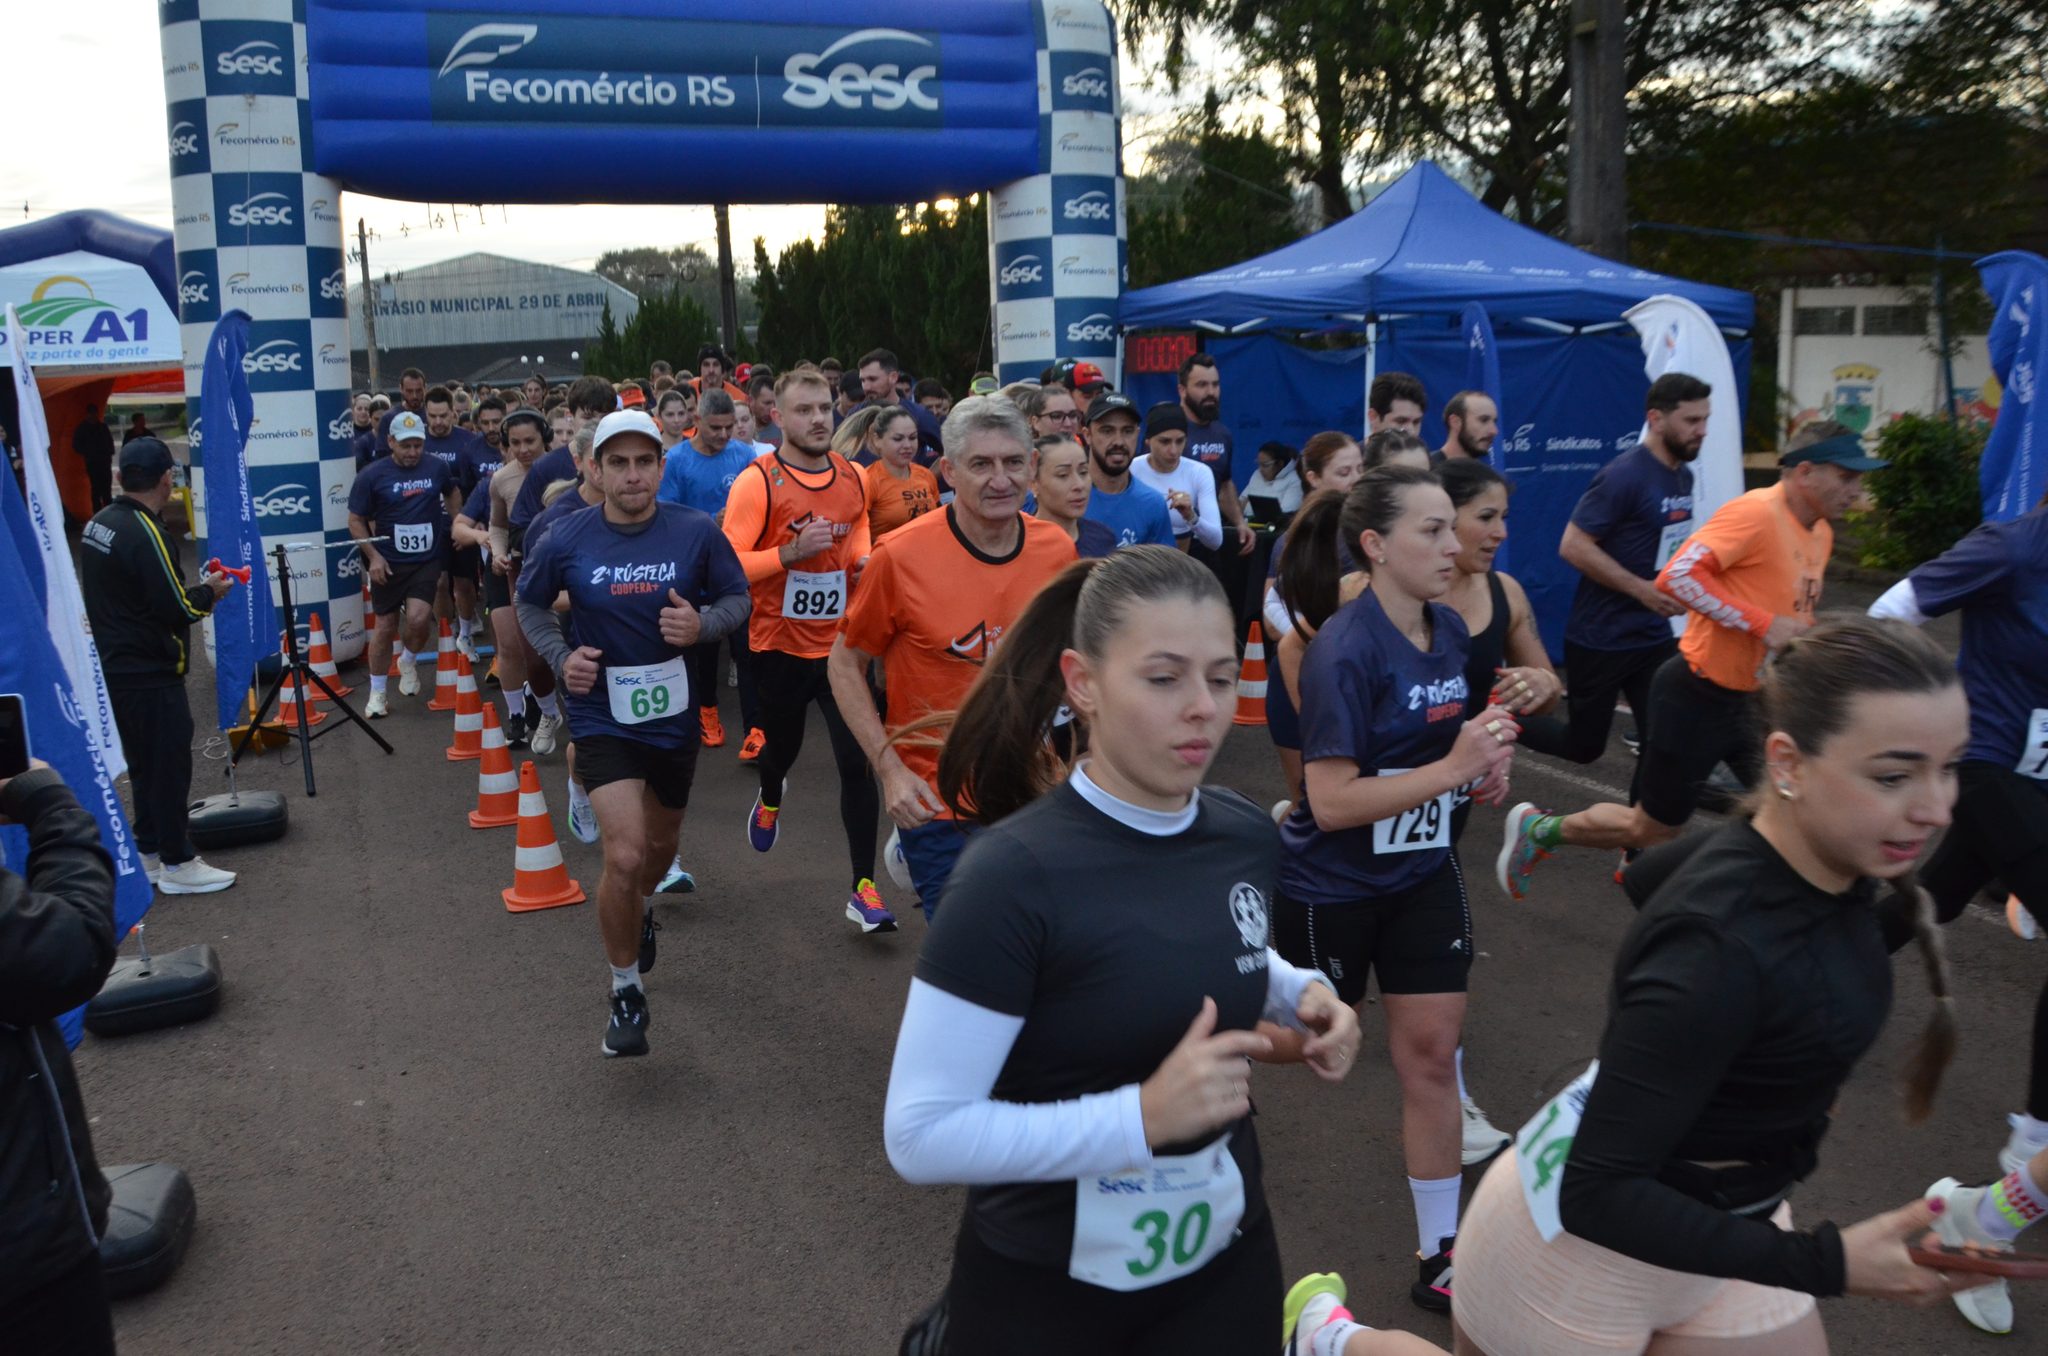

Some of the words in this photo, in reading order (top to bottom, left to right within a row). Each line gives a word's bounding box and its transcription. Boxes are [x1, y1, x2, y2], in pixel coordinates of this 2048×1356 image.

[217, 52, 282, 76] Sesc
[464, 71, 677, 106] Fecomércio
[687, 75, 735, 107] RS
[783, 52, 938, 111] Sesc
[220, 133, 279, 146] Fecomércio
[281, 136, 296, 146] RS
[228, 203, 292, 226] Sesc
[1063, 199, 1110, 220] Sesc
[1001, 264, 1042, 286] Sesc
[231, 283, 289, 295] Fecomércio
[291, 283, 304, 293] RS
[320, 277, 346, 299] Ses
[430, 296, 514, 314] MUNICIPAL
[519, 294, 539, 310] 29
[542, 293, 562, 308] DE
[566, 291, 608, 307] ABRIL
[82, 308, 149, 344] A1
[1066, 322, 1113, 342] Sesc
[42, 348, 82, 362] parte
[86, 345, 104, 359] da
[105, 345, 150, 360] gente
[241, 351, 302, 374] Sesc
[248, 430, 299, 442] ecomércio
[300, 428, 314, 438] RS
[328, 419, 354, 441] Ses
[400, 534, 428, 550] 931
[310, 569, 323, 578] RS
[337, 557, 362, 578] Ses
[613, 561, 676, 583] RÚSTICA
[792, 589, 840, 616] 892
[615, 675, 642, 686] Sesc
[630, 684, 670, 719] 69
[84, 729, 136, 877] Fecomércio
[1388, 798, 1441, 845] 729
[1125, 1200, 1212, 1278] 30
